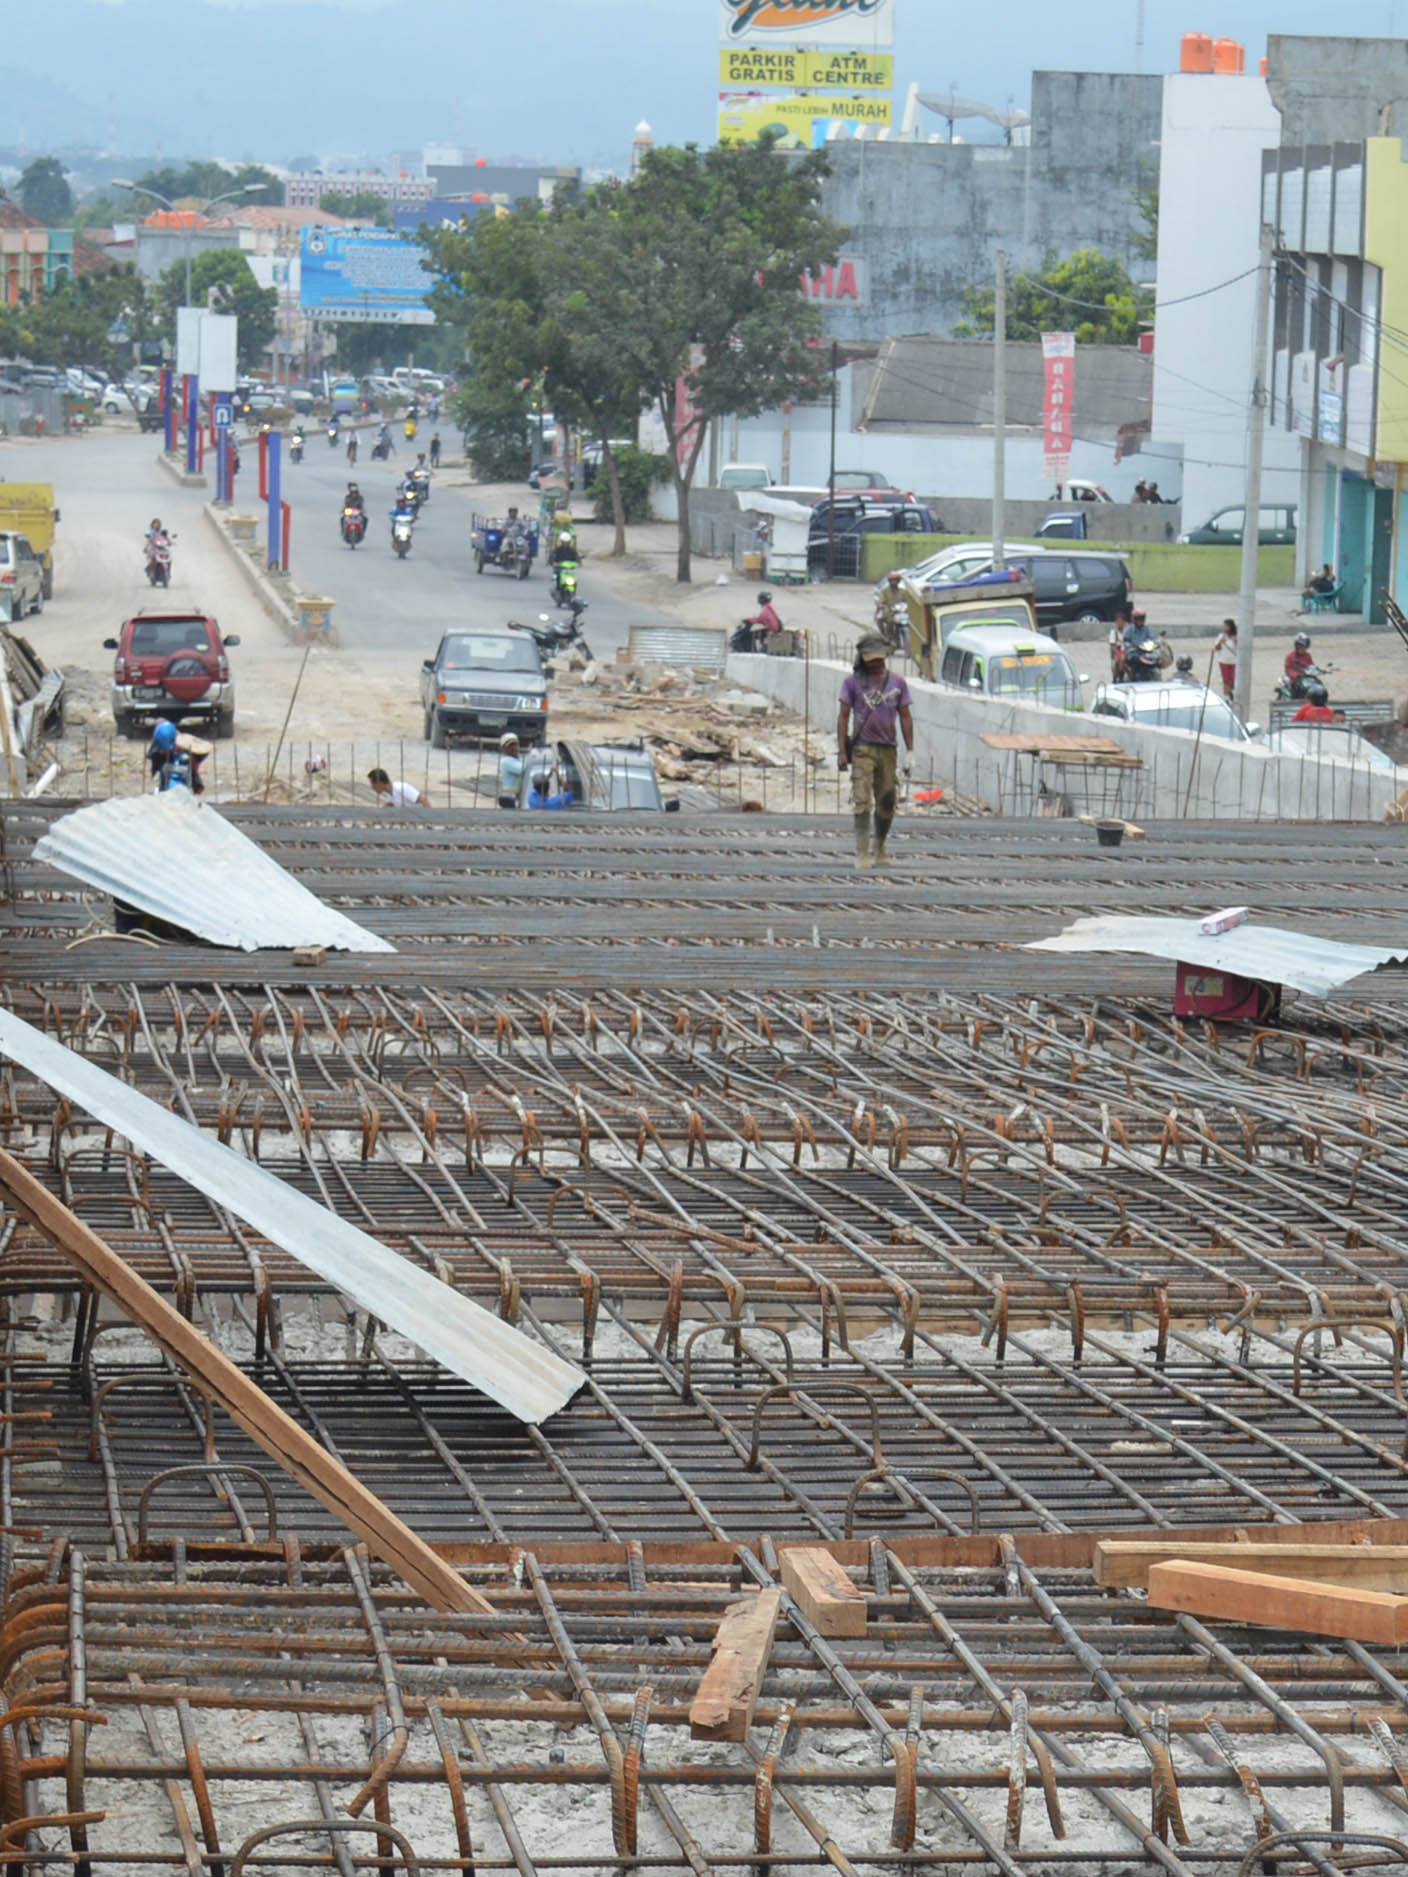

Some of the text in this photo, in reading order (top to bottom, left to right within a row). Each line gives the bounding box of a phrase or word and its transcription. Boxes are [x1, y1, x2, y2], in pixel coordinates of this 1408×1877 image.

[729, 54, 796, 67] PARKIR
[830, 57, 868, 70] ATM
[729, 68, 796, 82] GRATIS
[812, 70, 885, 85] CENTRE
[831, 103, 888, 118] MURAH
